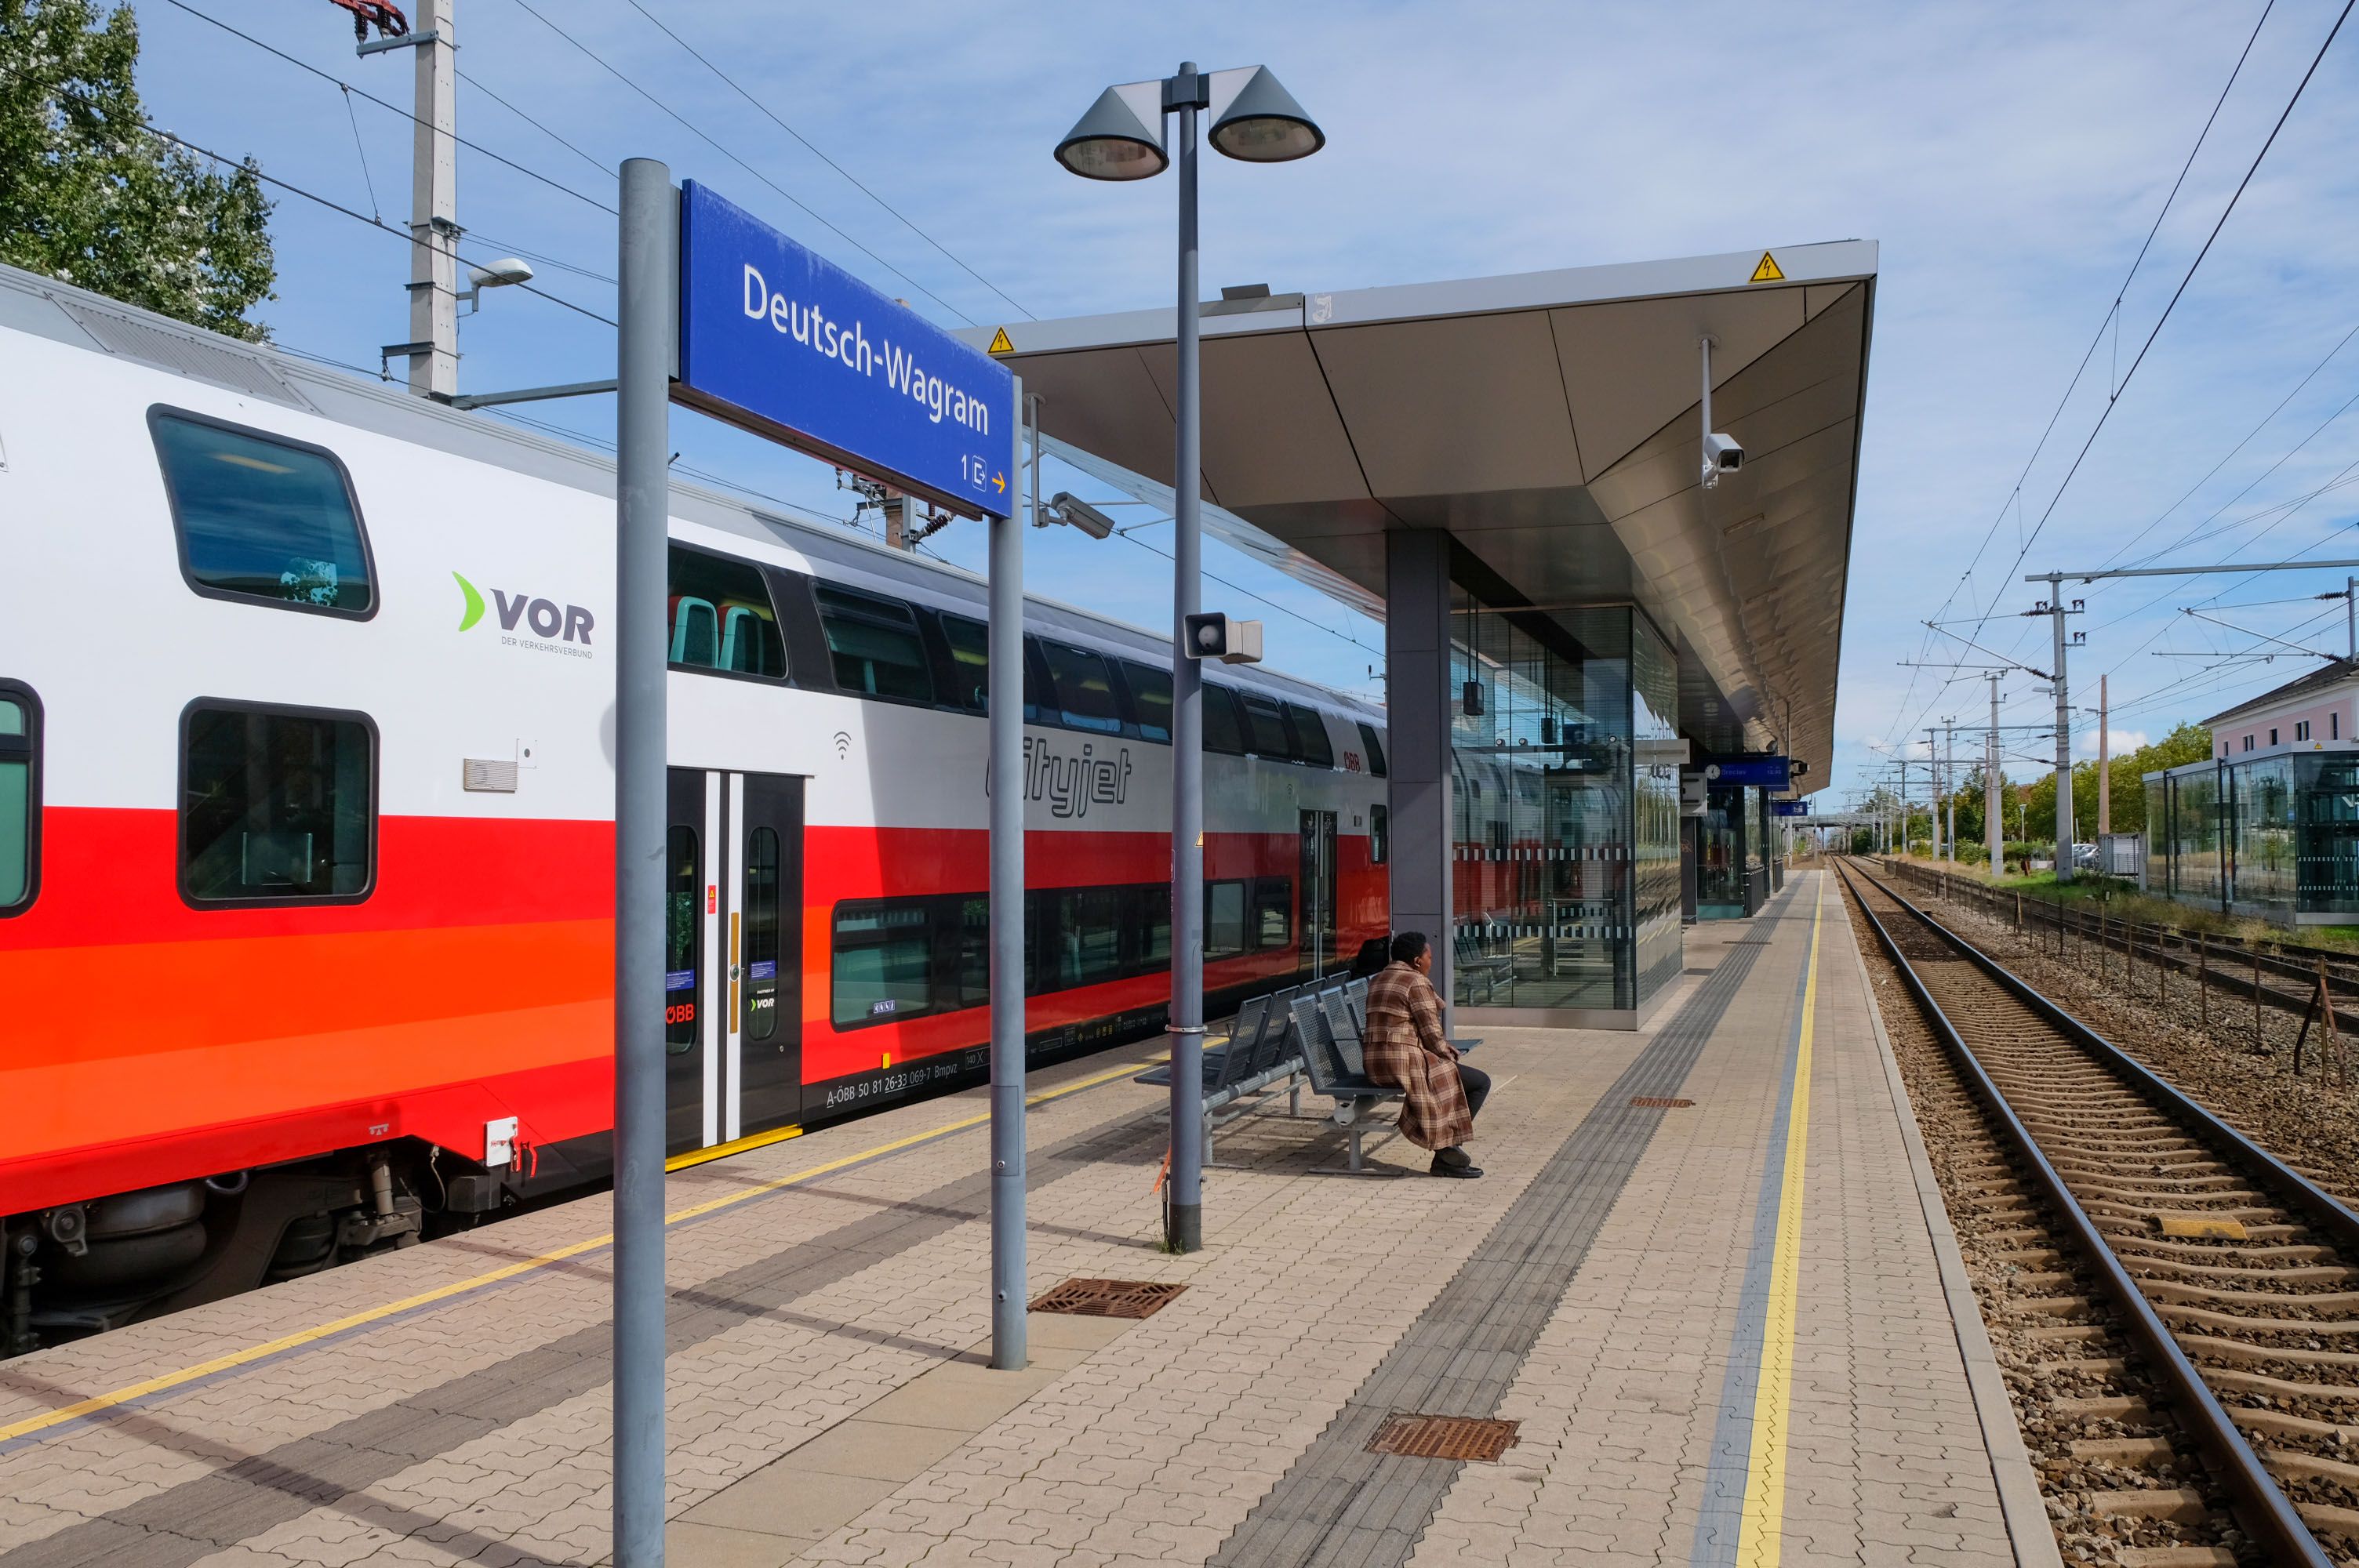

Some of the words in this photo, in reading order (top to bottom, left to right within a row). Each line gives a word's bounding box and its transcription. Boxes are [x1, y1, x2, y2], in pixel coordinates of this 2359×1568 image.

[744, 263, 988, 435] Deutsch-Wagram
[961, 454, 967, 480] 1
[489, 588, 594, 645] VOR
[501, 636, 518, 647] DER
[519, 639, 593, 659] VERKEHRSVERBUND
[985, 736, 1132, 818] ityjet
[666, 1004, 694, 1024] ÖBB
[757, 998, 775, 1008] VOR
[967, 1054, 976, 1065] 140
[827, 1085, 855, 1106] A-ÖBB
[858, 1083, 869, 1097] 50
[872, 1080, 881, 1094] 81
[885, 1075, 907, 1091] 26-33
[910, 1067, 931, 1084] 069-7
[934, 1063, 958, 1079] Bmpvz
